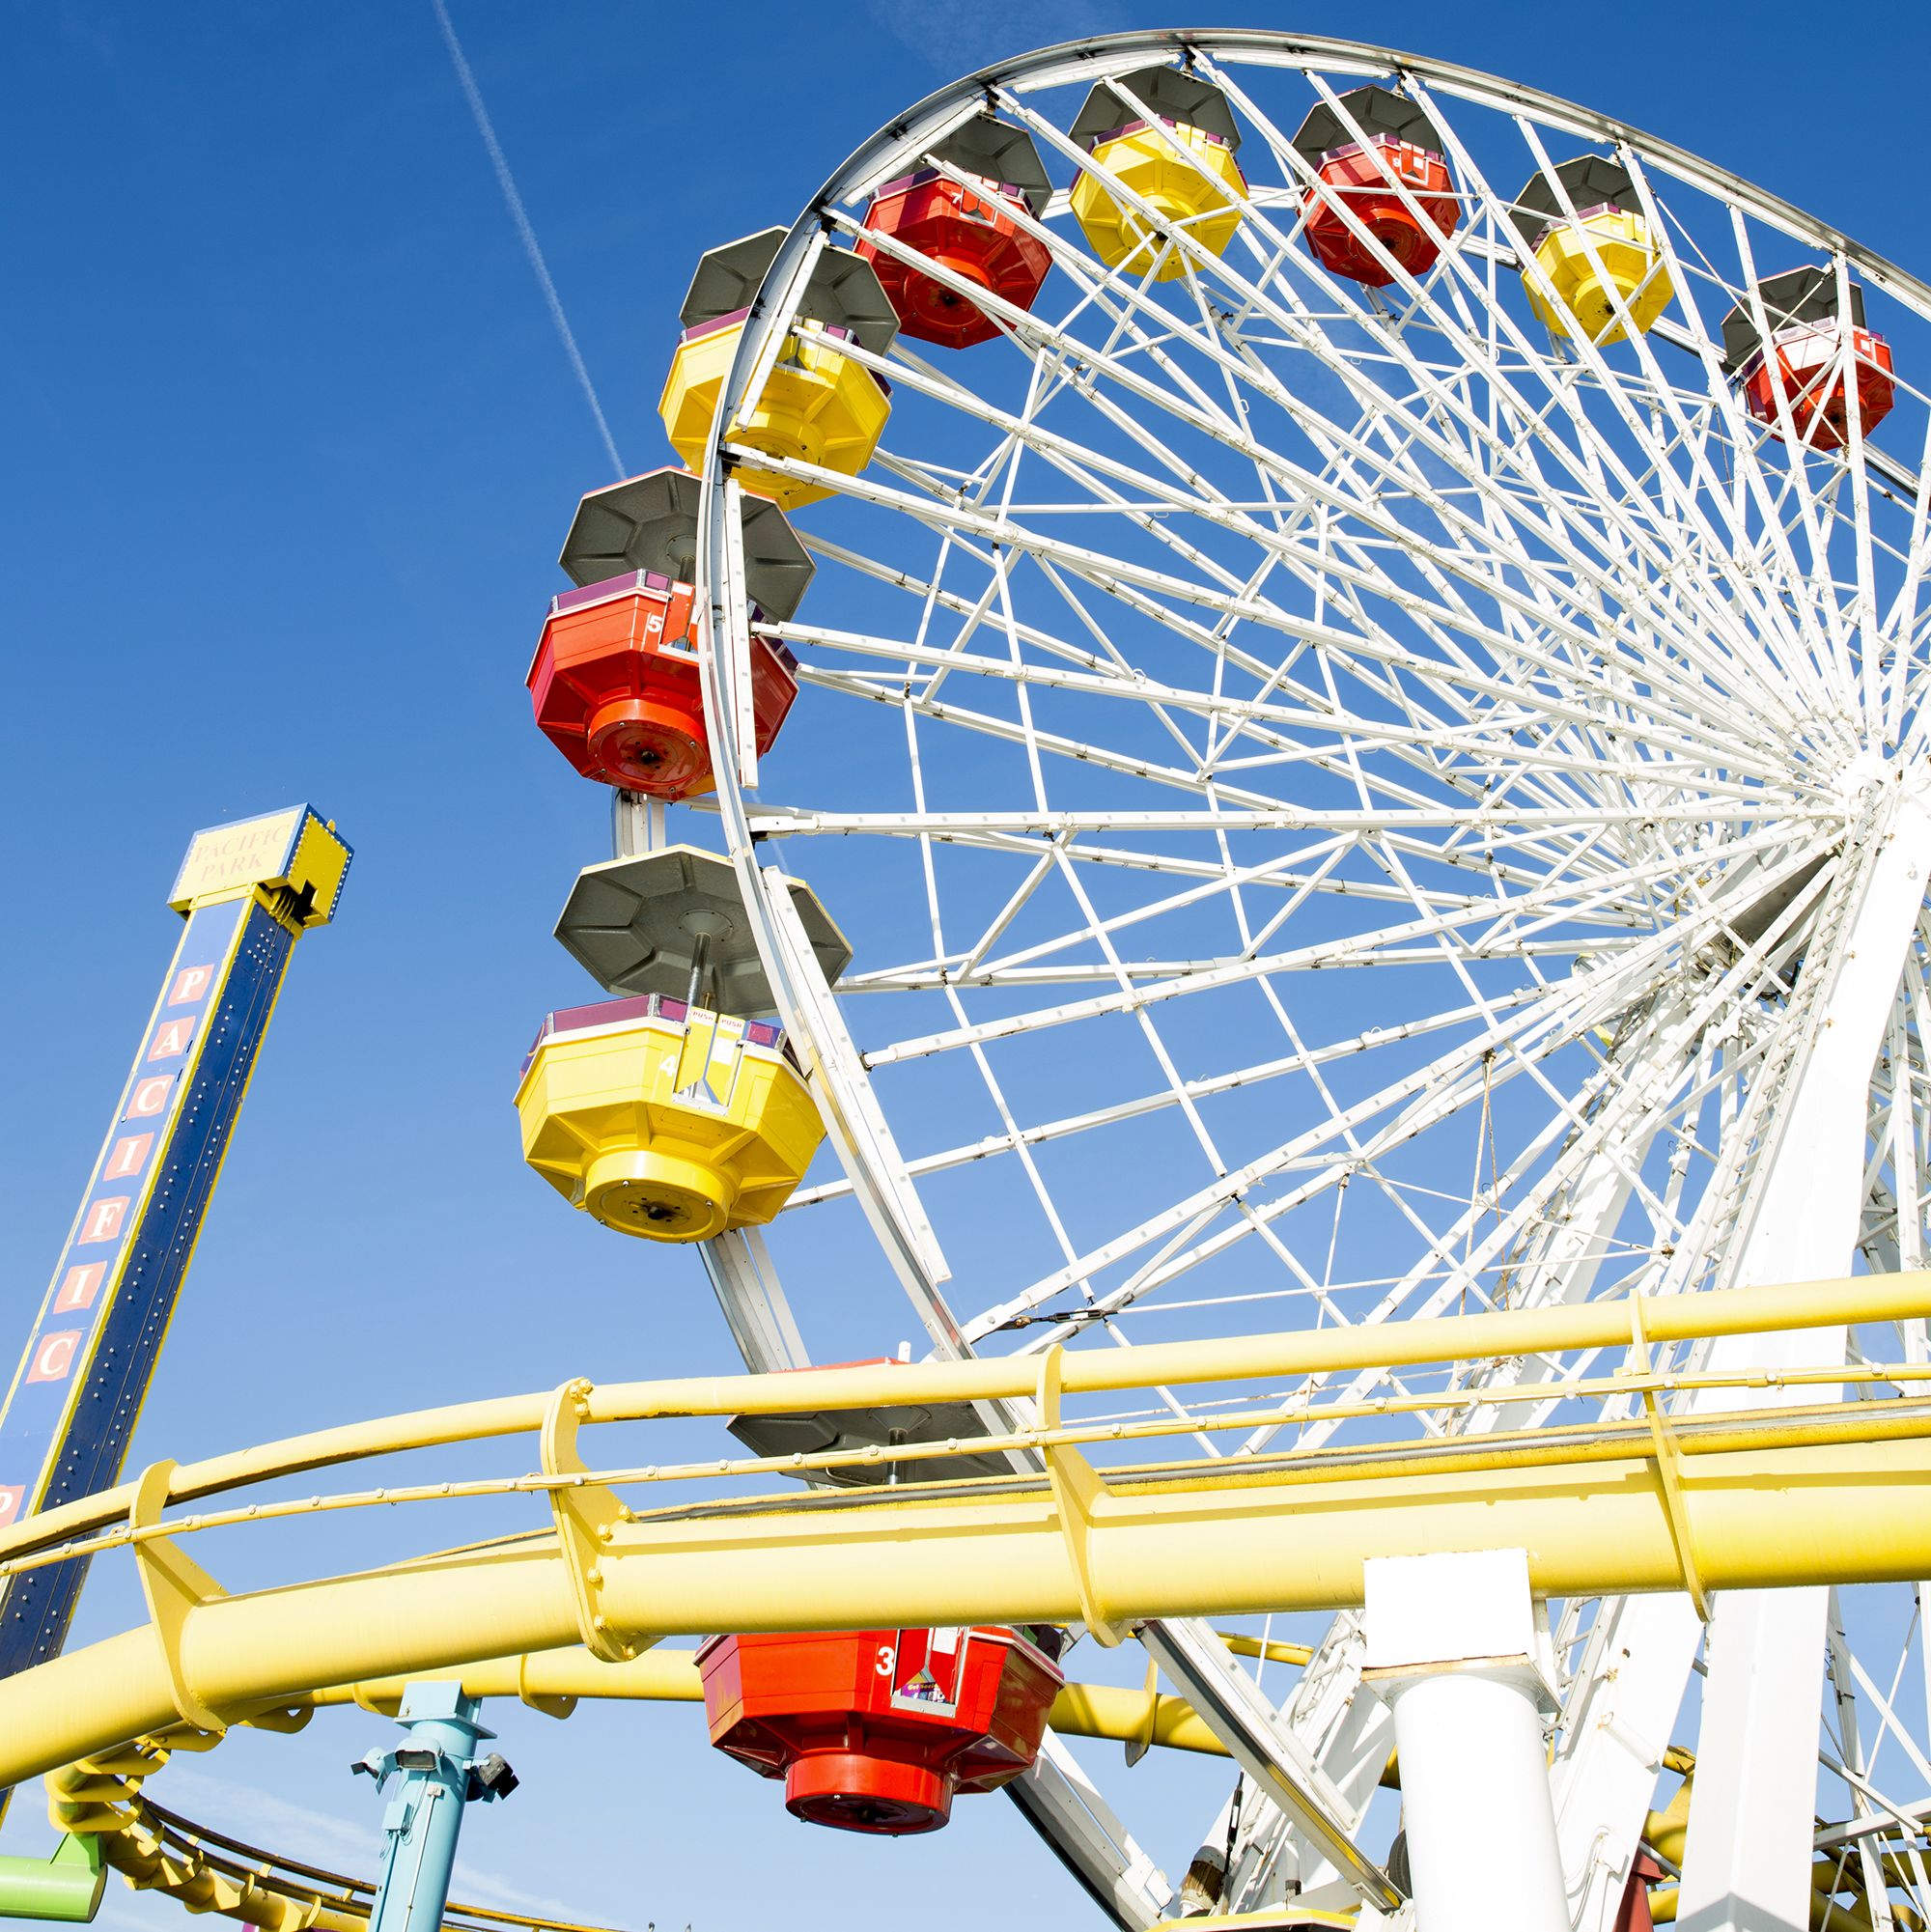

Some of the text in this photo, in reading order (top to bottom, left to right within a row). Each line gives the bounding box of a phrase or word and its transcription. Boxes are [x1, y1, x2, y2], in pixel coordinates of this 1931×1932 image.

[952, 192, 962, 204] 7
[648, 615, 662, 632] 5
[195, 826, 290, 862] PACIFIC
[201, 854, 262, 881] PARK
[692, 1011, 714, 1021] PUSH
[721, 1019, 742, 1028] PUSH
[659, 1055, 677, 1078] 4
[876, 1646, 894, 1675] 3
